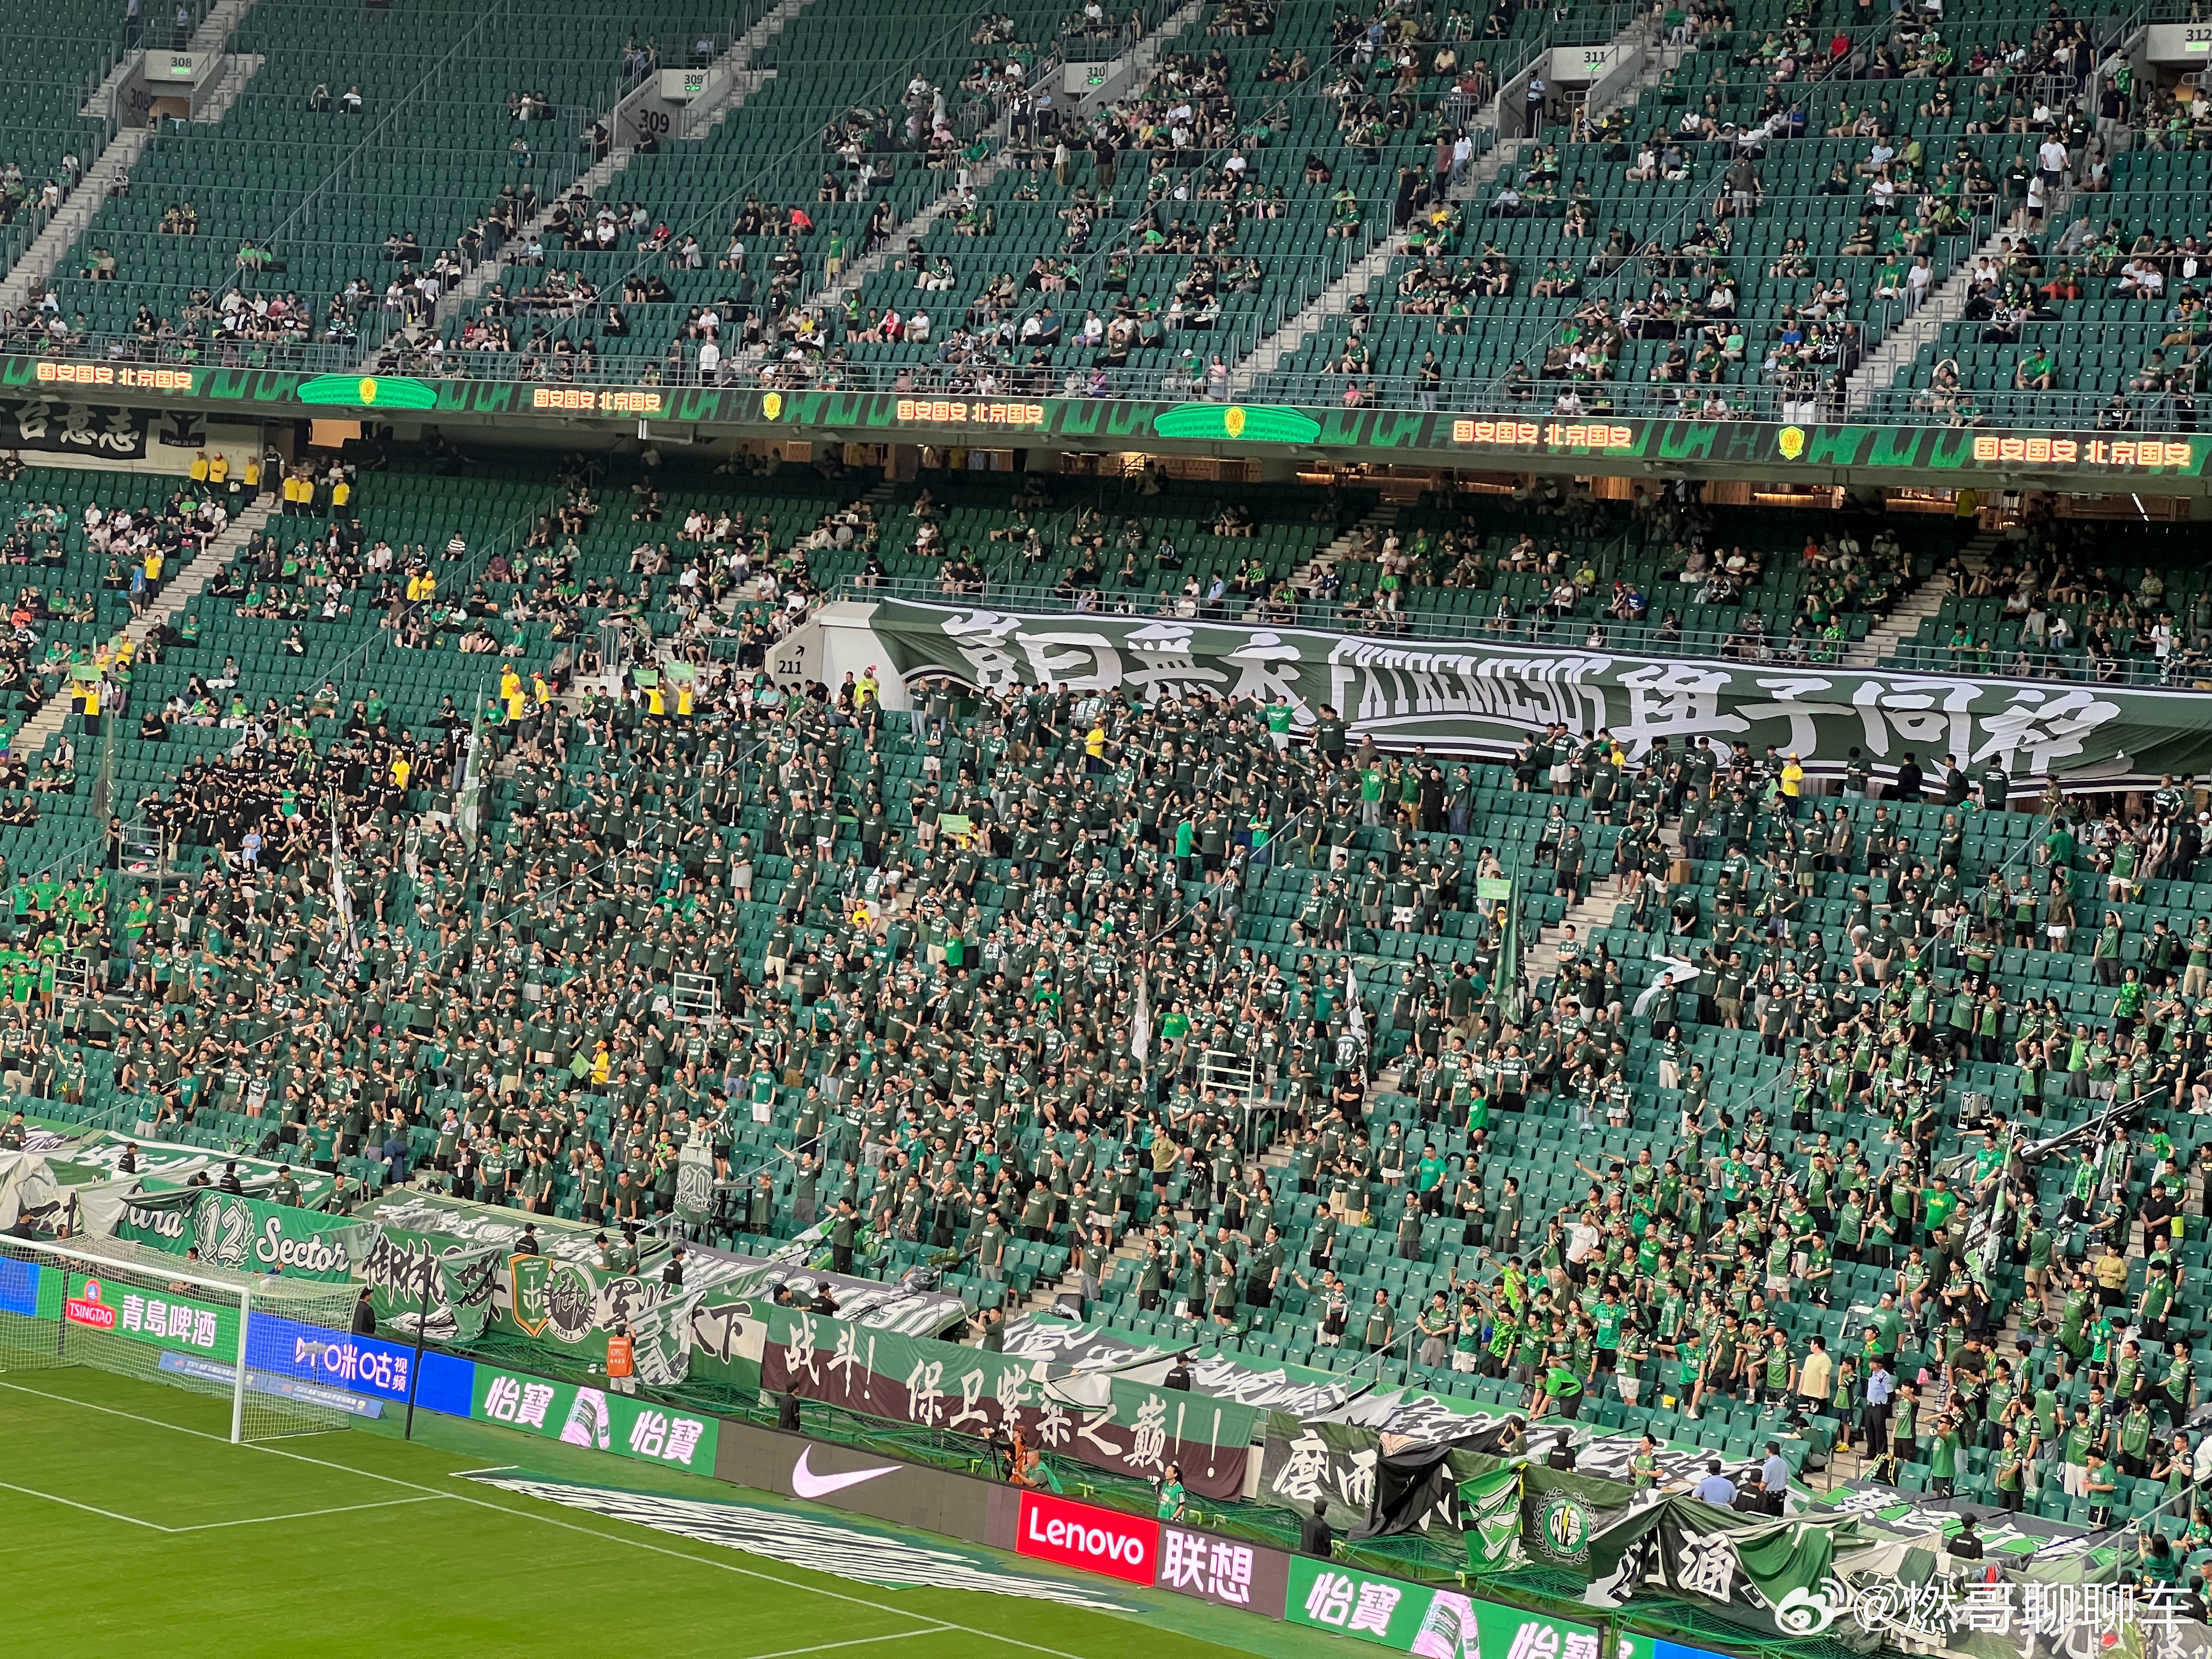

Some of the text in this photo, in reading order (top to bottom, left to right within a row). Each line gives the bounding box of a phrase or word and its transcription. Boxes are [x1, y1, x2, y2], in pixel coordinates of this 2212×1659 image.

[2185, 29, 2212, 42] 312
[171, 57, 192, 67] 308
[1583, 51, 1605, 63] 311
[684, 74, 703, 84] 309
[1087, 67, 1105, 77] 310
[130, 88, 151, 111] 308
[639, 109, 670, 133] 309
[37, 362, 192, 390] 国安国安 北京国安
[533, 388, 661, 412] 国安国安 北京国安
[896, 400, 1044, 425] 国安国安 北京国安
[1453, 420, 1632, 448] 国安国安 北京国安
[1973, 437, 2191, 466] 国安国安 北京国安
[778, 660, 802, 674] 211
[1338, 1042, 1353, 1060] 92
[201, 1201, 245, 1262] 12
[256, 1217, 349, 1272] Sector
[69, 1302, 112, 1325] TSINGTAO
[122, 1294, 217, 1348] 青島啤酒
[484, 1376, 554, 1429] 怡寶
[629, 1410, 704, 1465] 怡寶
[1029, 1507, 1144, 1565] Lenovo
[1161, 1529, 1254, 1604] 联想
[1305, 1572, 1401, 1637] 怡寶
